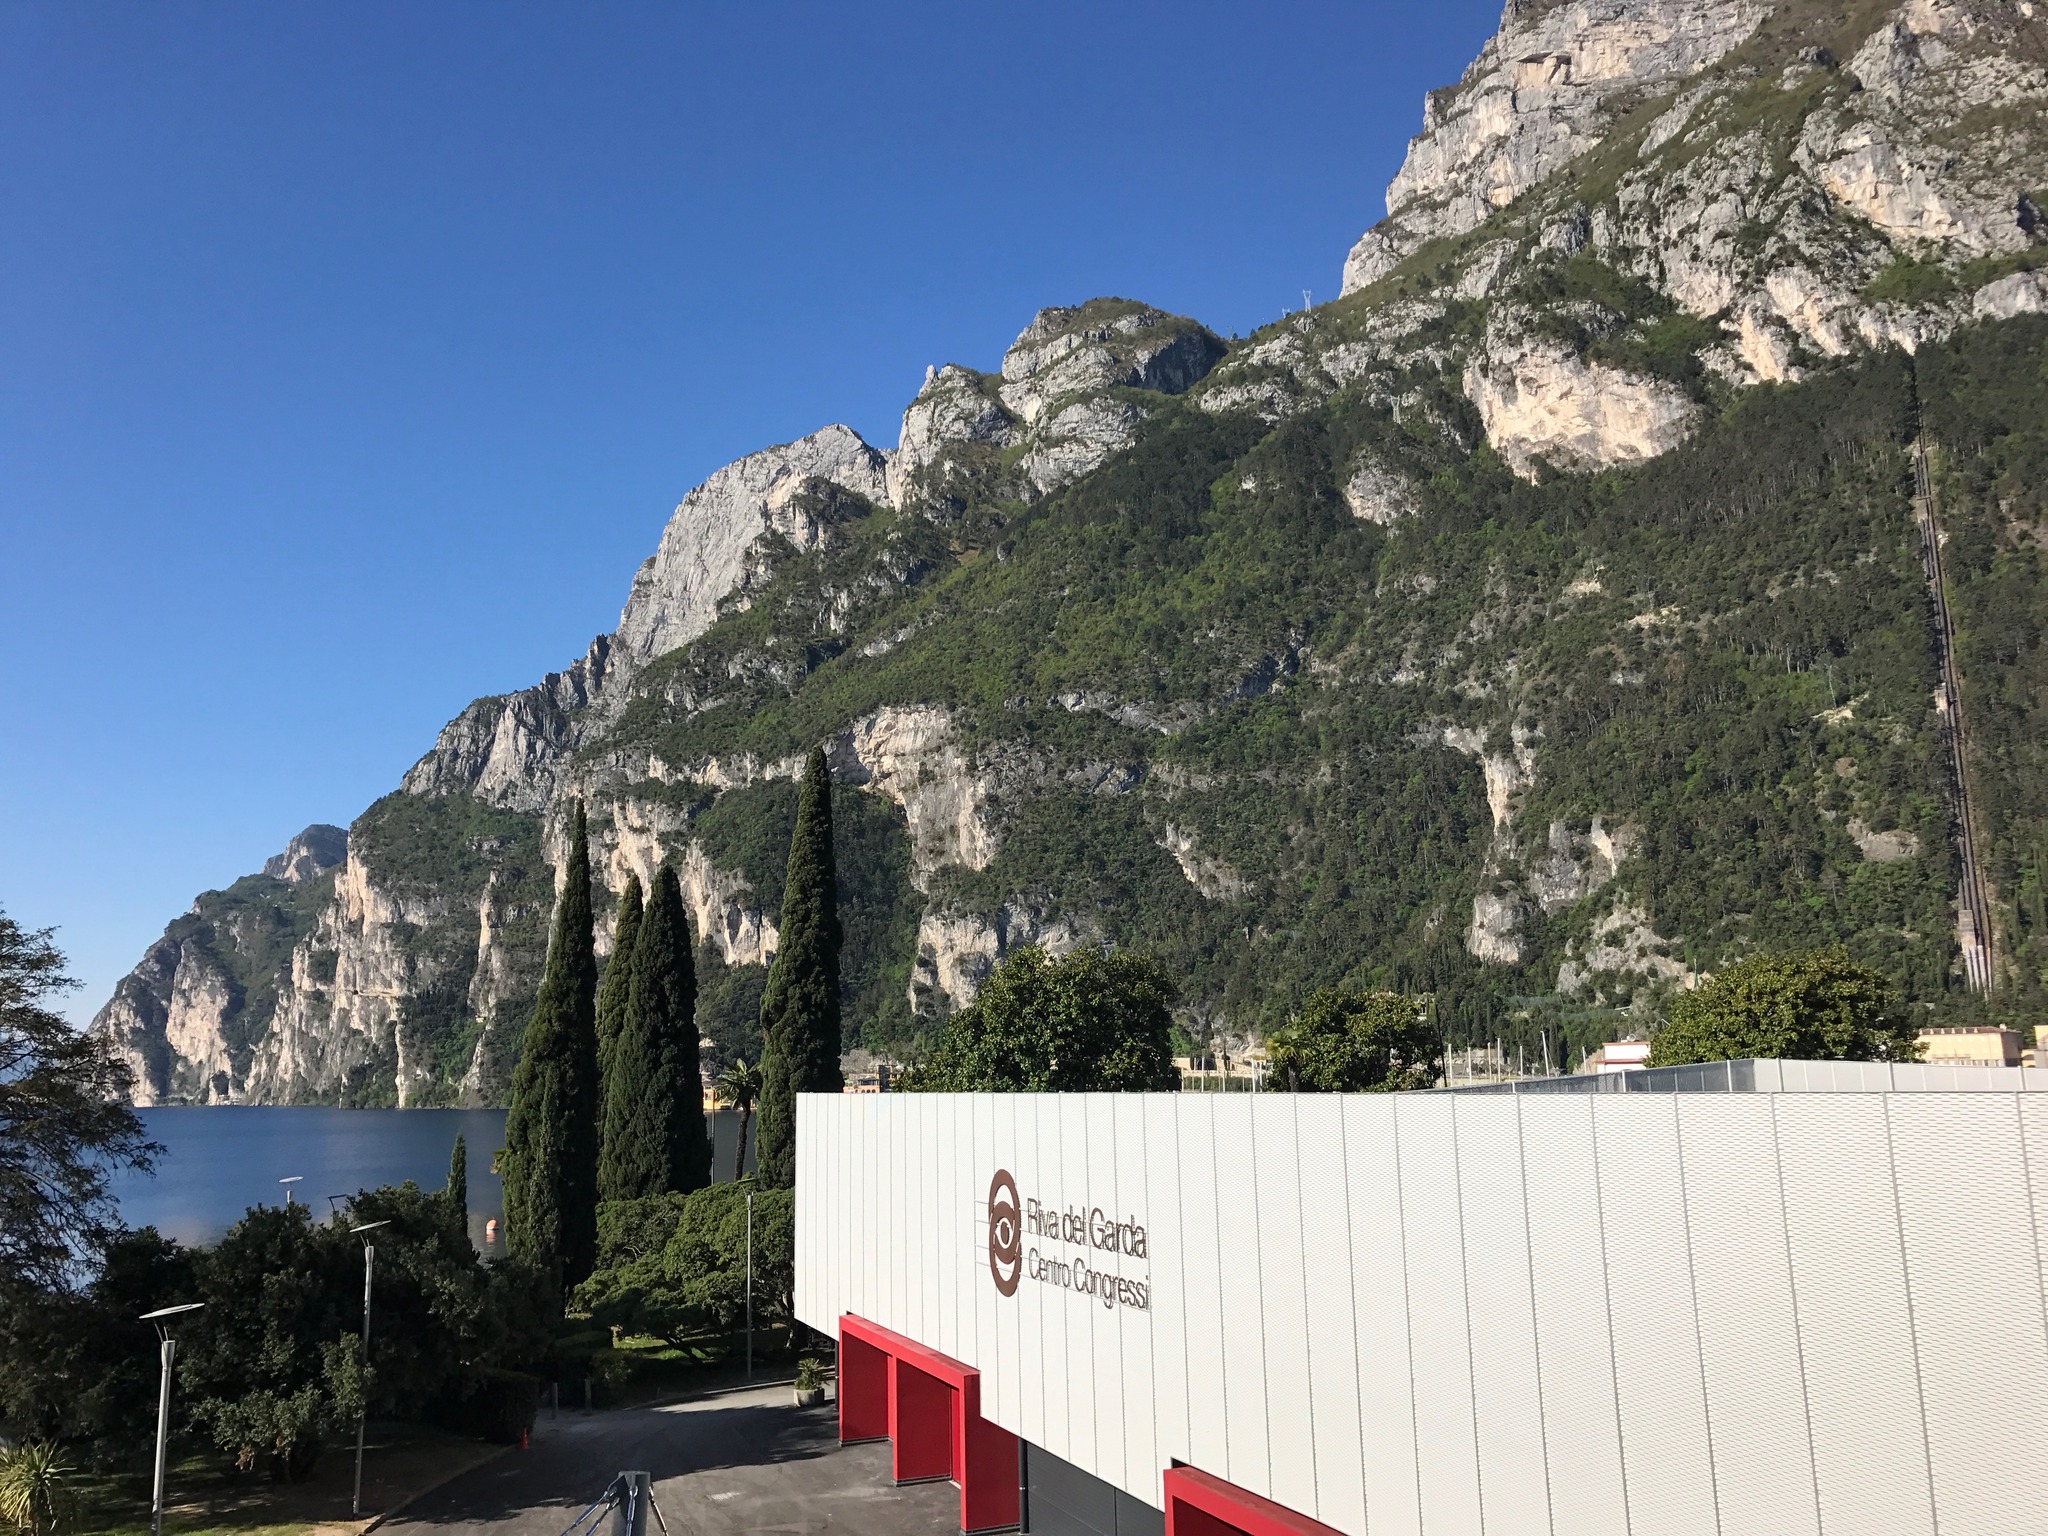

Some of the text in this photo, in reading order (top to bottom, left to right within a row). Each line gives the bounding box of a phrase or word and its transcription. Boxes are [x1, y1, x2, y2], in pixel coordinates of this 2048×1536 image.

[1027, 1198, 1148, 1259] Riva del Garda
[1028, 1247, 1149, 1310] Centro Congressi
